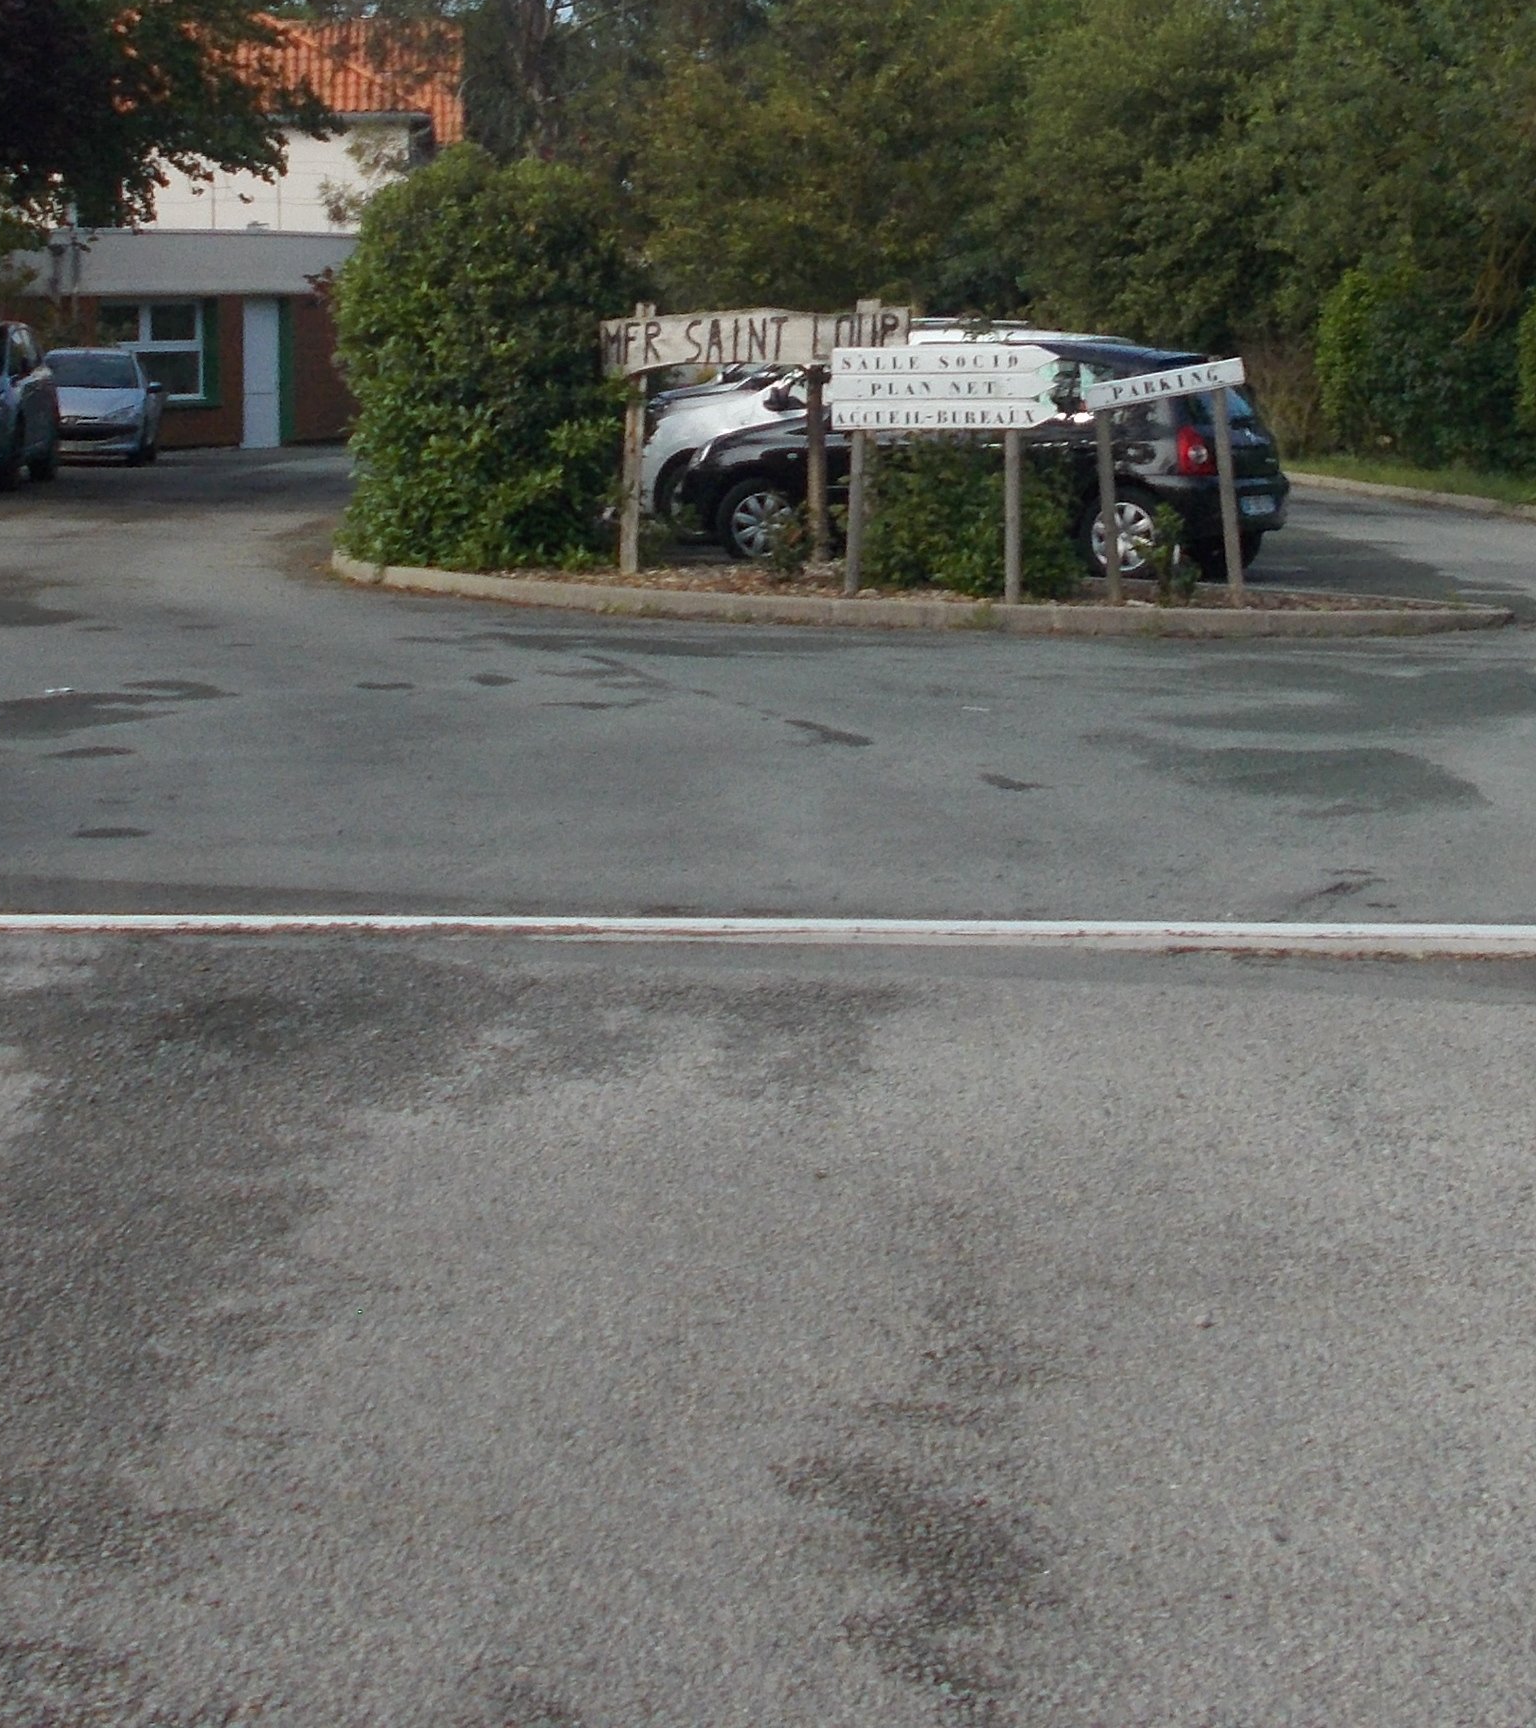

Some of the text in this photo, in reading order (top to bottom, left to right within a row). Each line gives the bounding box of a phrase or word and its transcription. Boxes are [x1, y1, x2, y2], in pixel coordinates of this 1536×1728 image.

[602, 321, 662, 365] MFR
[685, 315, 789, 363] SAINT
[841, 355, 921, 371] SALLE
[870, 380, 998, 396] PLAN NET
[1112, 367, 1220, 401] PARKING
[834, 408, 1037, 425] ACCUEIL-BUREAUX
